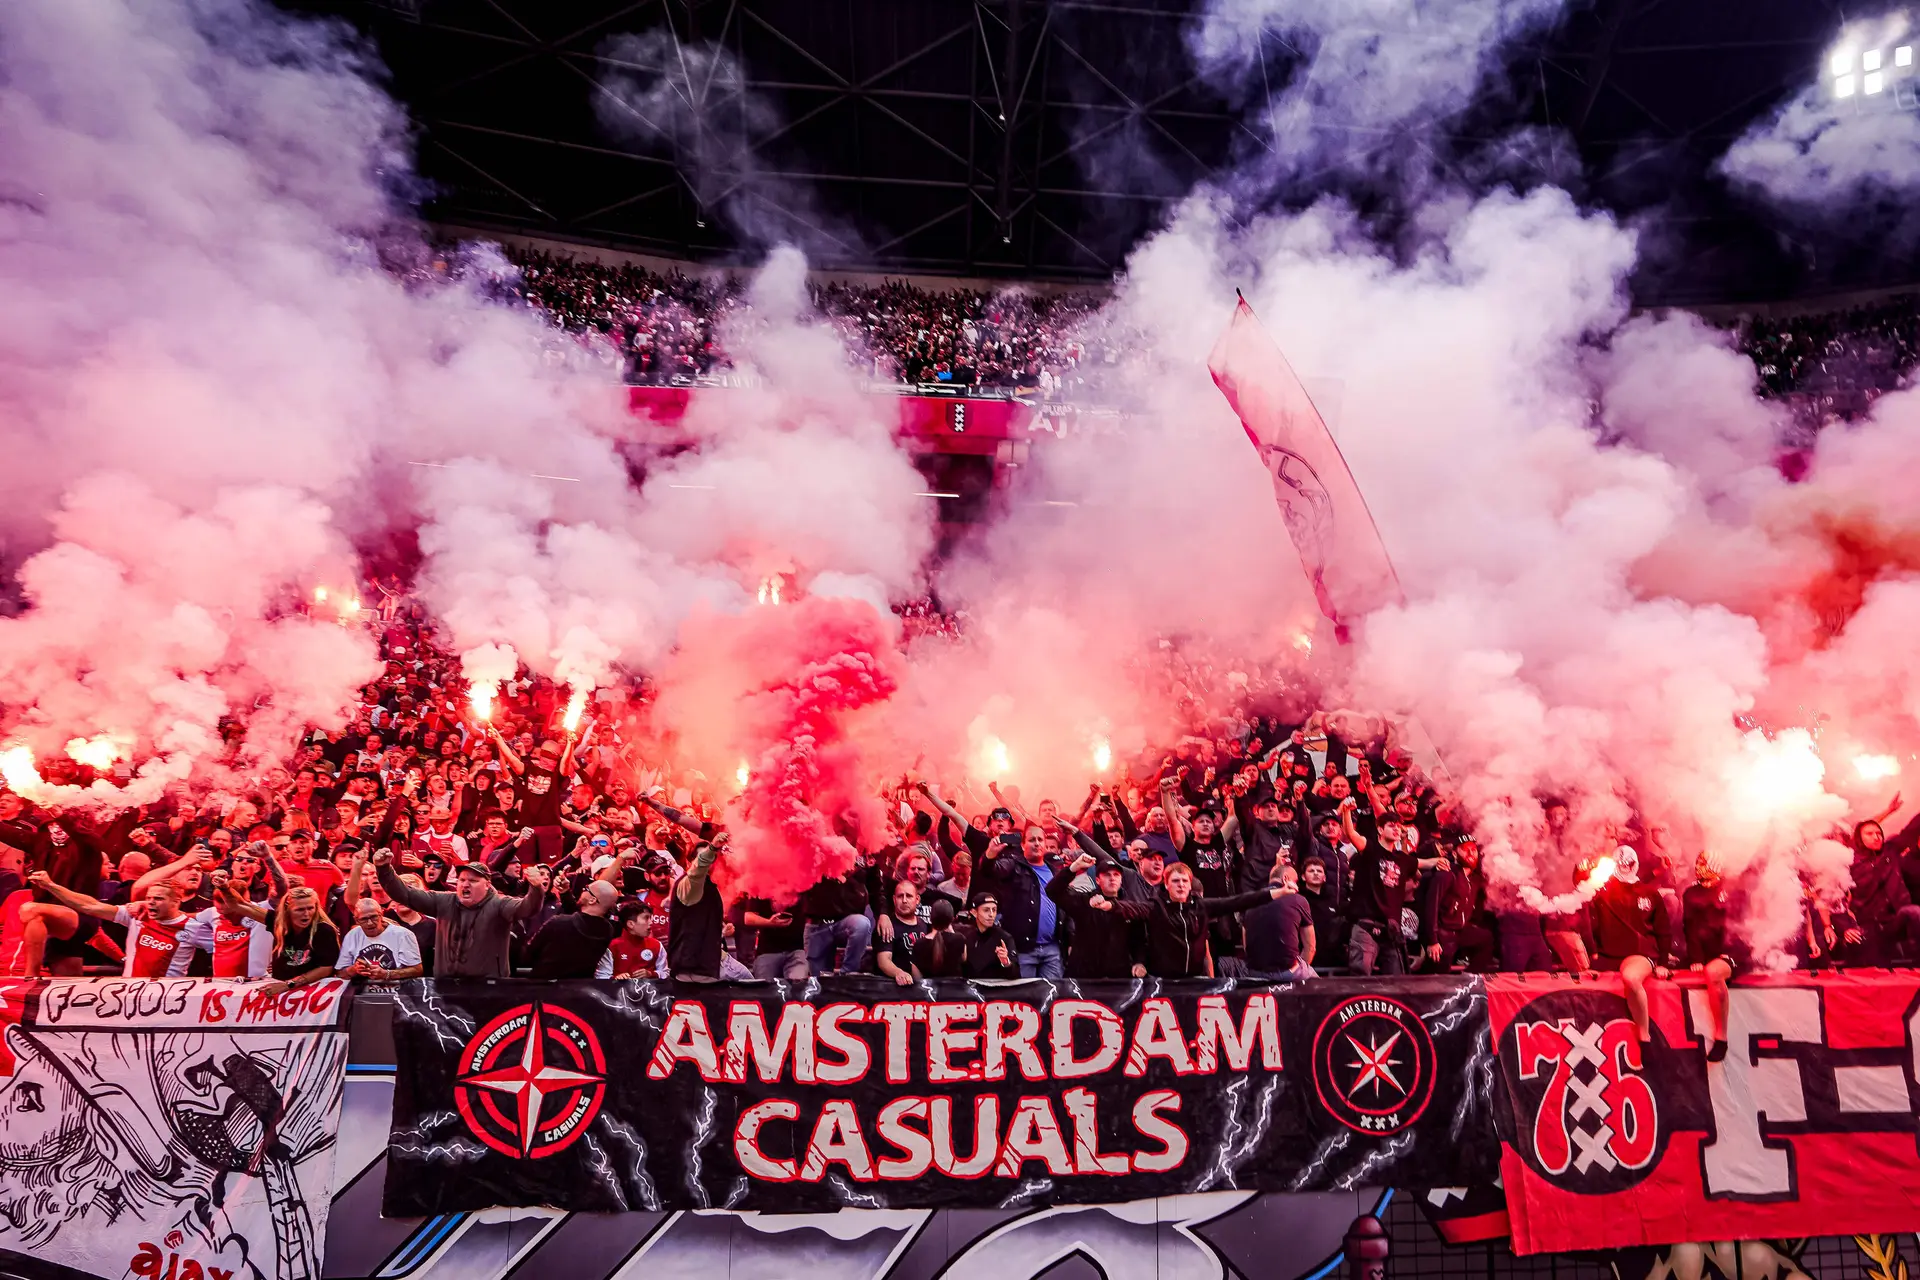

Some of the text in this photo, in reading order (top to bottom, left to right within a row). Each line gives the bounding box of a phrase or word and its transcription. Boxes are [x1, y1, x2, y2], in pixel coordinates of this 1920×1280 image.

[139, 934, 174, 951] Ziggo
[216, 930, 247, 942] Ziggo
[198, 988, 232, 1024] IS
[236, 979, 343, 1025] MAGIC
[1338, 999, 1404, 1023] AMSTERDAM
[470, 1015, 528, 1072] AMSTERDAM
[648, 996, 1284, 1083] AMSTERDAM
[1686, 986, 1920, 1198] F-
[544, 1095, 592, 1143] CASUALS
[735, 1087, 1190, 1182] CASUALS
